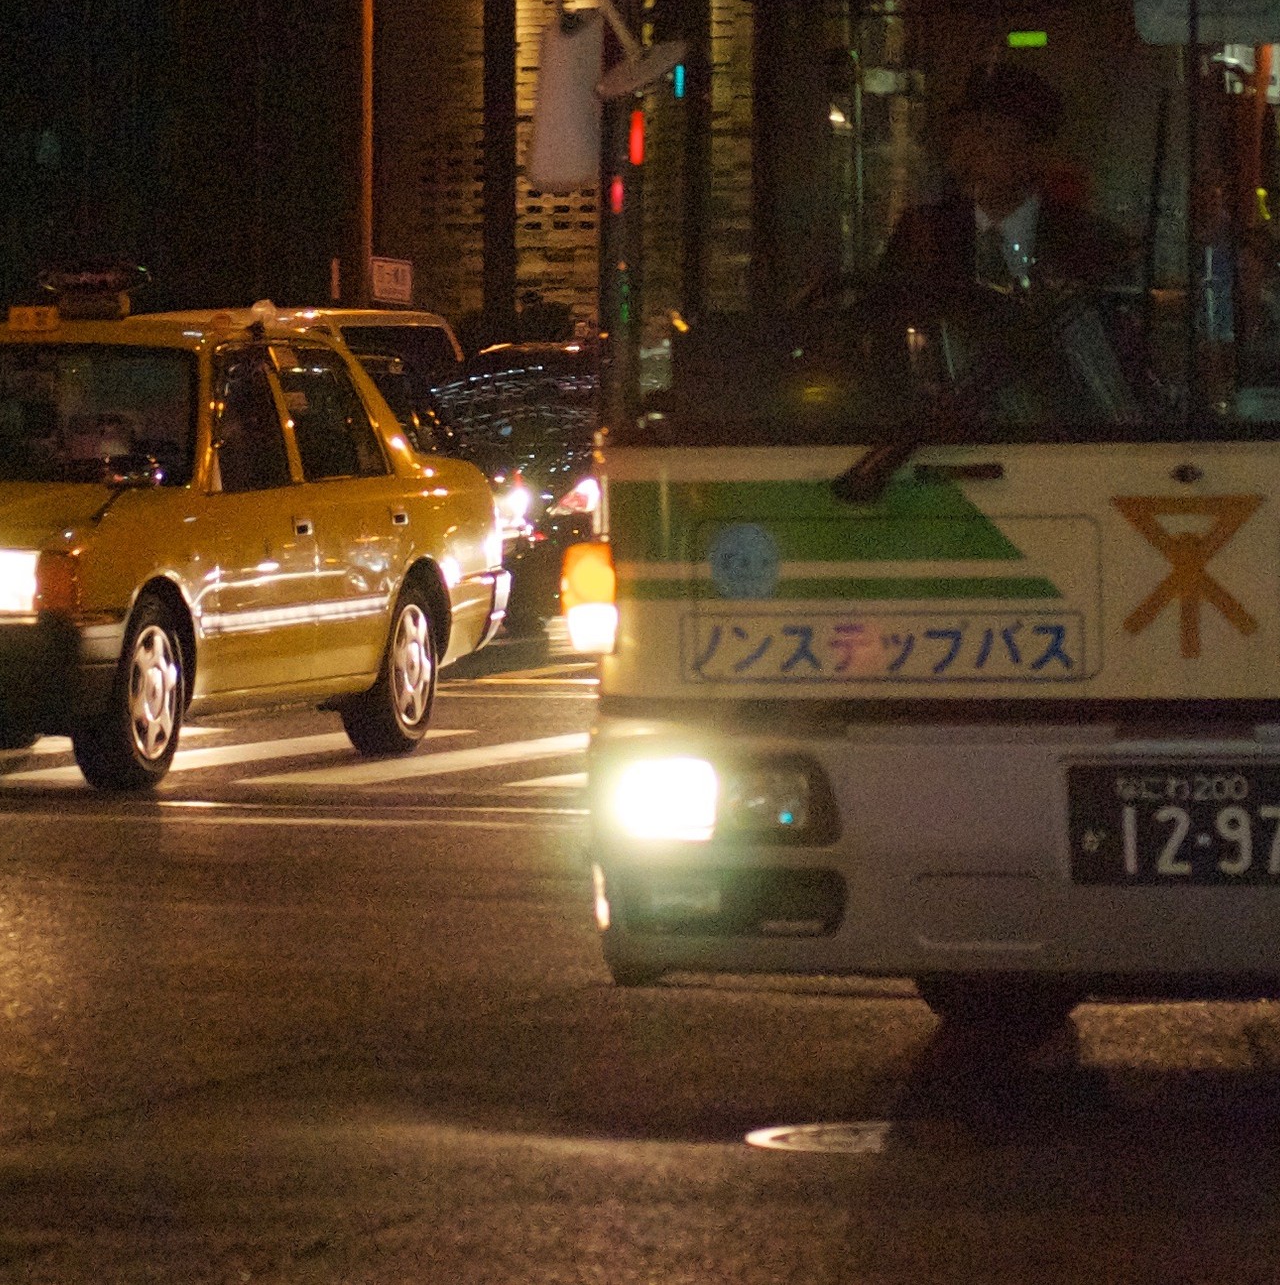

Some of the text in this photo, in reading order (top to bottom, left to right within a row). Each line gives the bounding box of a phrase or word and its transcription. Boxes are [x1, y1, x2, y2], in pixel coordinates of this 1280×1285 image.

[693, 623, 1075, 675] ノンステップバス
[1192, 774, 1250, 801] 200
